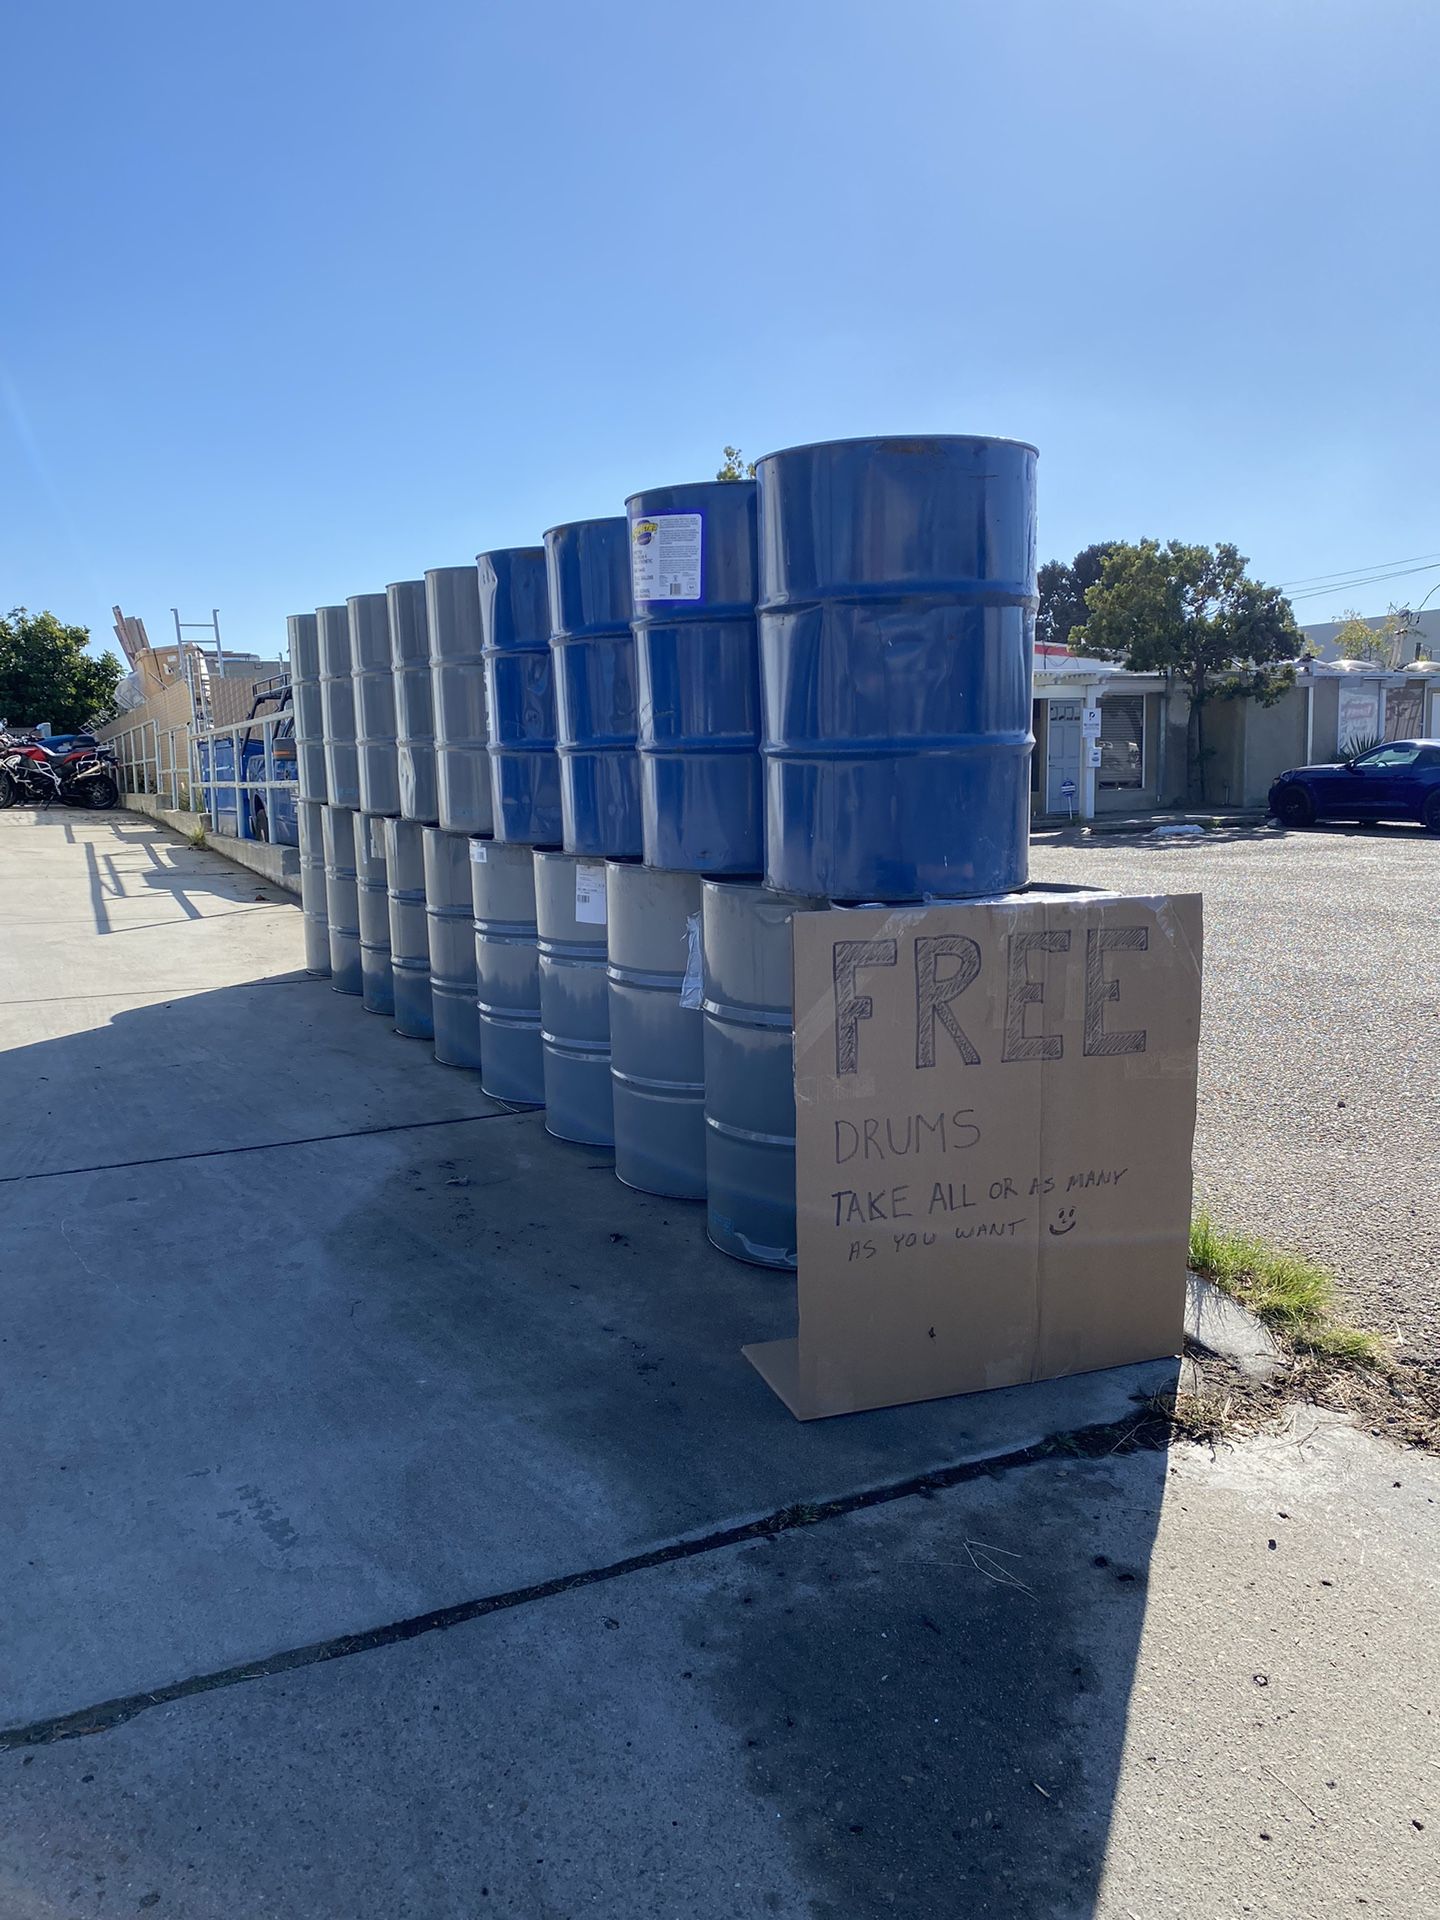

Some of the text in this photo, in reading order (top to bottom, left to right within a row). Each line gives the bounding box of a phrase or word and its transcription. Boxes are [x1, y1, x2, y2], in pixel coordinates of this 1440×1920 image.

[833, 926, 1149, 1076] FREE
[835, 1109, 981, 1164] DRUMS
[831, 1168, 1128, 1226] TAKE ALL OR AS MANY
[849, 1218, 1027, 1261] AS YOU WANT
